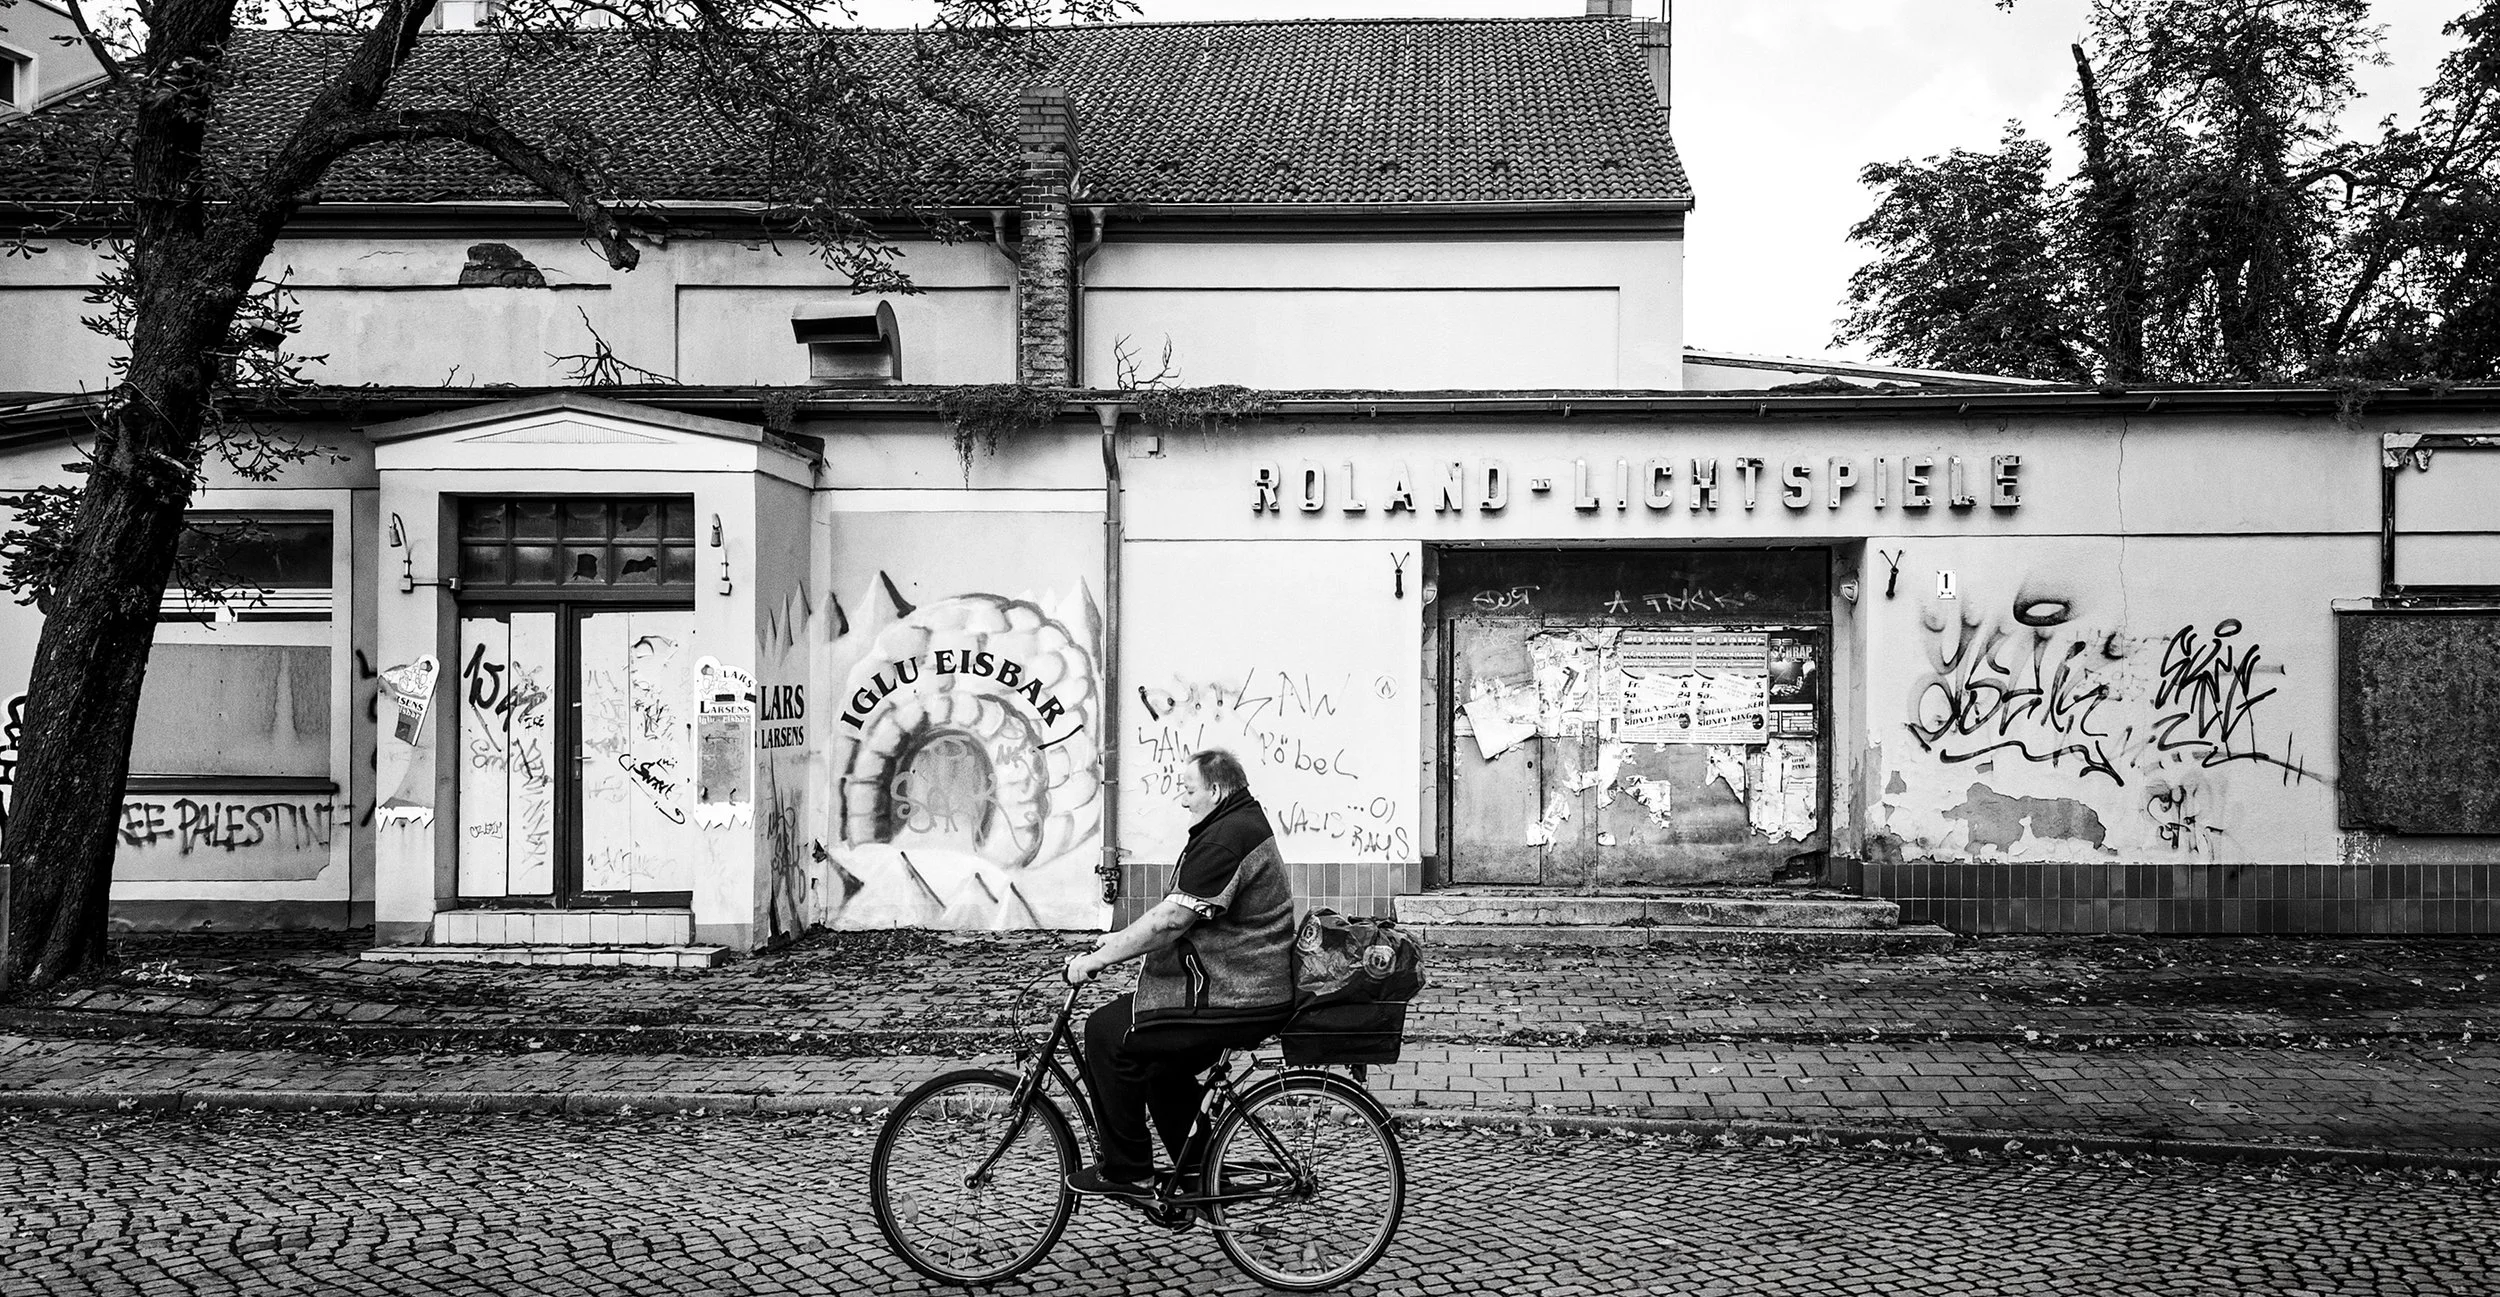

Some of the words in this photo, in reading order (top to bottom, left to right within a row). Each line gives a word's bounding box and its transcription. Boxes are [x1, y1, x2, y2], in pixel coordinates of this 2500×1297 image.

[1943, 573, 1949, 589] 1
[723, 670, 753, 688] LARS
[840, 656, 919, 731] IGLU
[934, 649, 1066, 728] EISBAR
[700, 701, 750, 713] LARSENS
[760, 684, 805, 721] LARS
[761, 726, 804, 750] LARSENS
